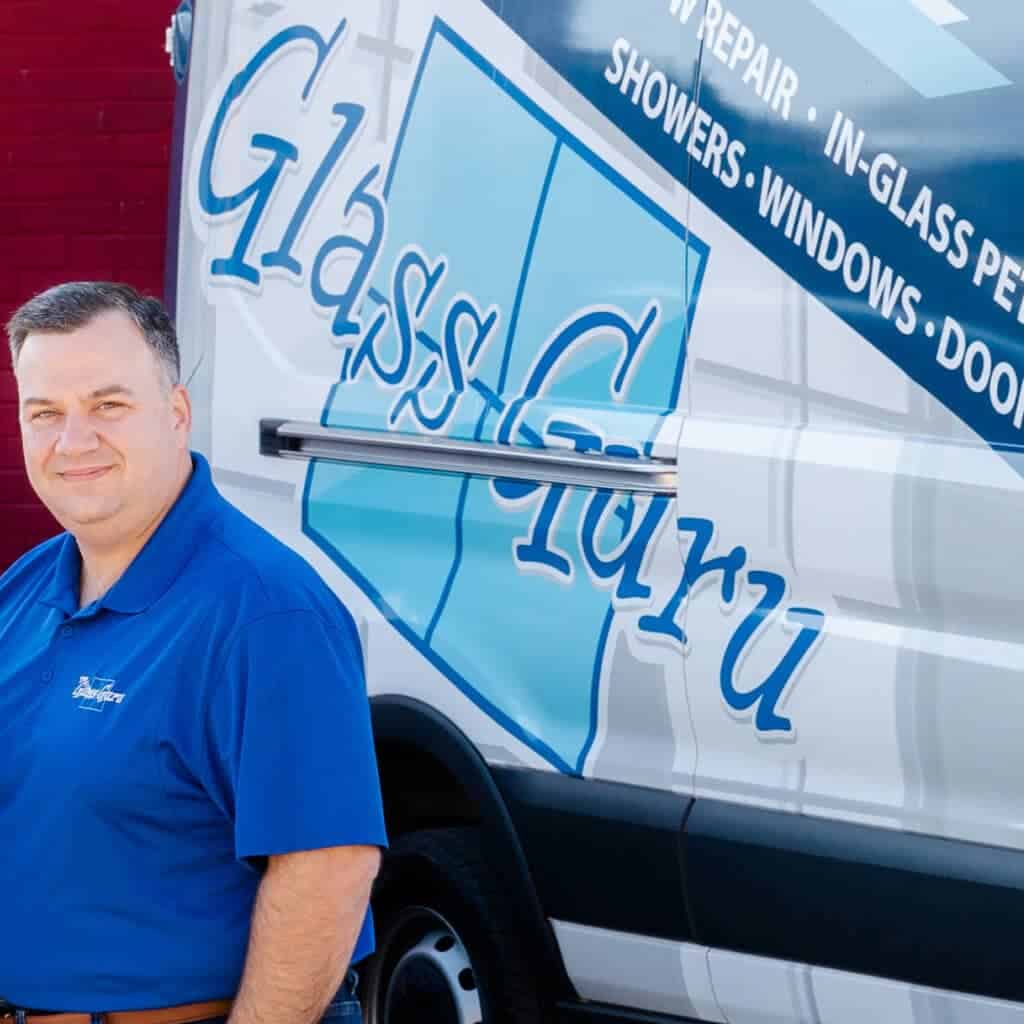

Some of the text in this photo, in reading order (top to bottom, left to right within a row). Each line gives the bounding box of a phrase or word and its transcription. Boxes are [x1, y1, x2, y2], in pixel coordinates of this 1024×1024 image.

[196, 18, 500, 432] Glass
[604, 37, 1024, 430] SHOWERS WINDOWS DOO
[696, 0, 799, 121] REPAIR
[824, 111, 975, 270] IN-GLASS
